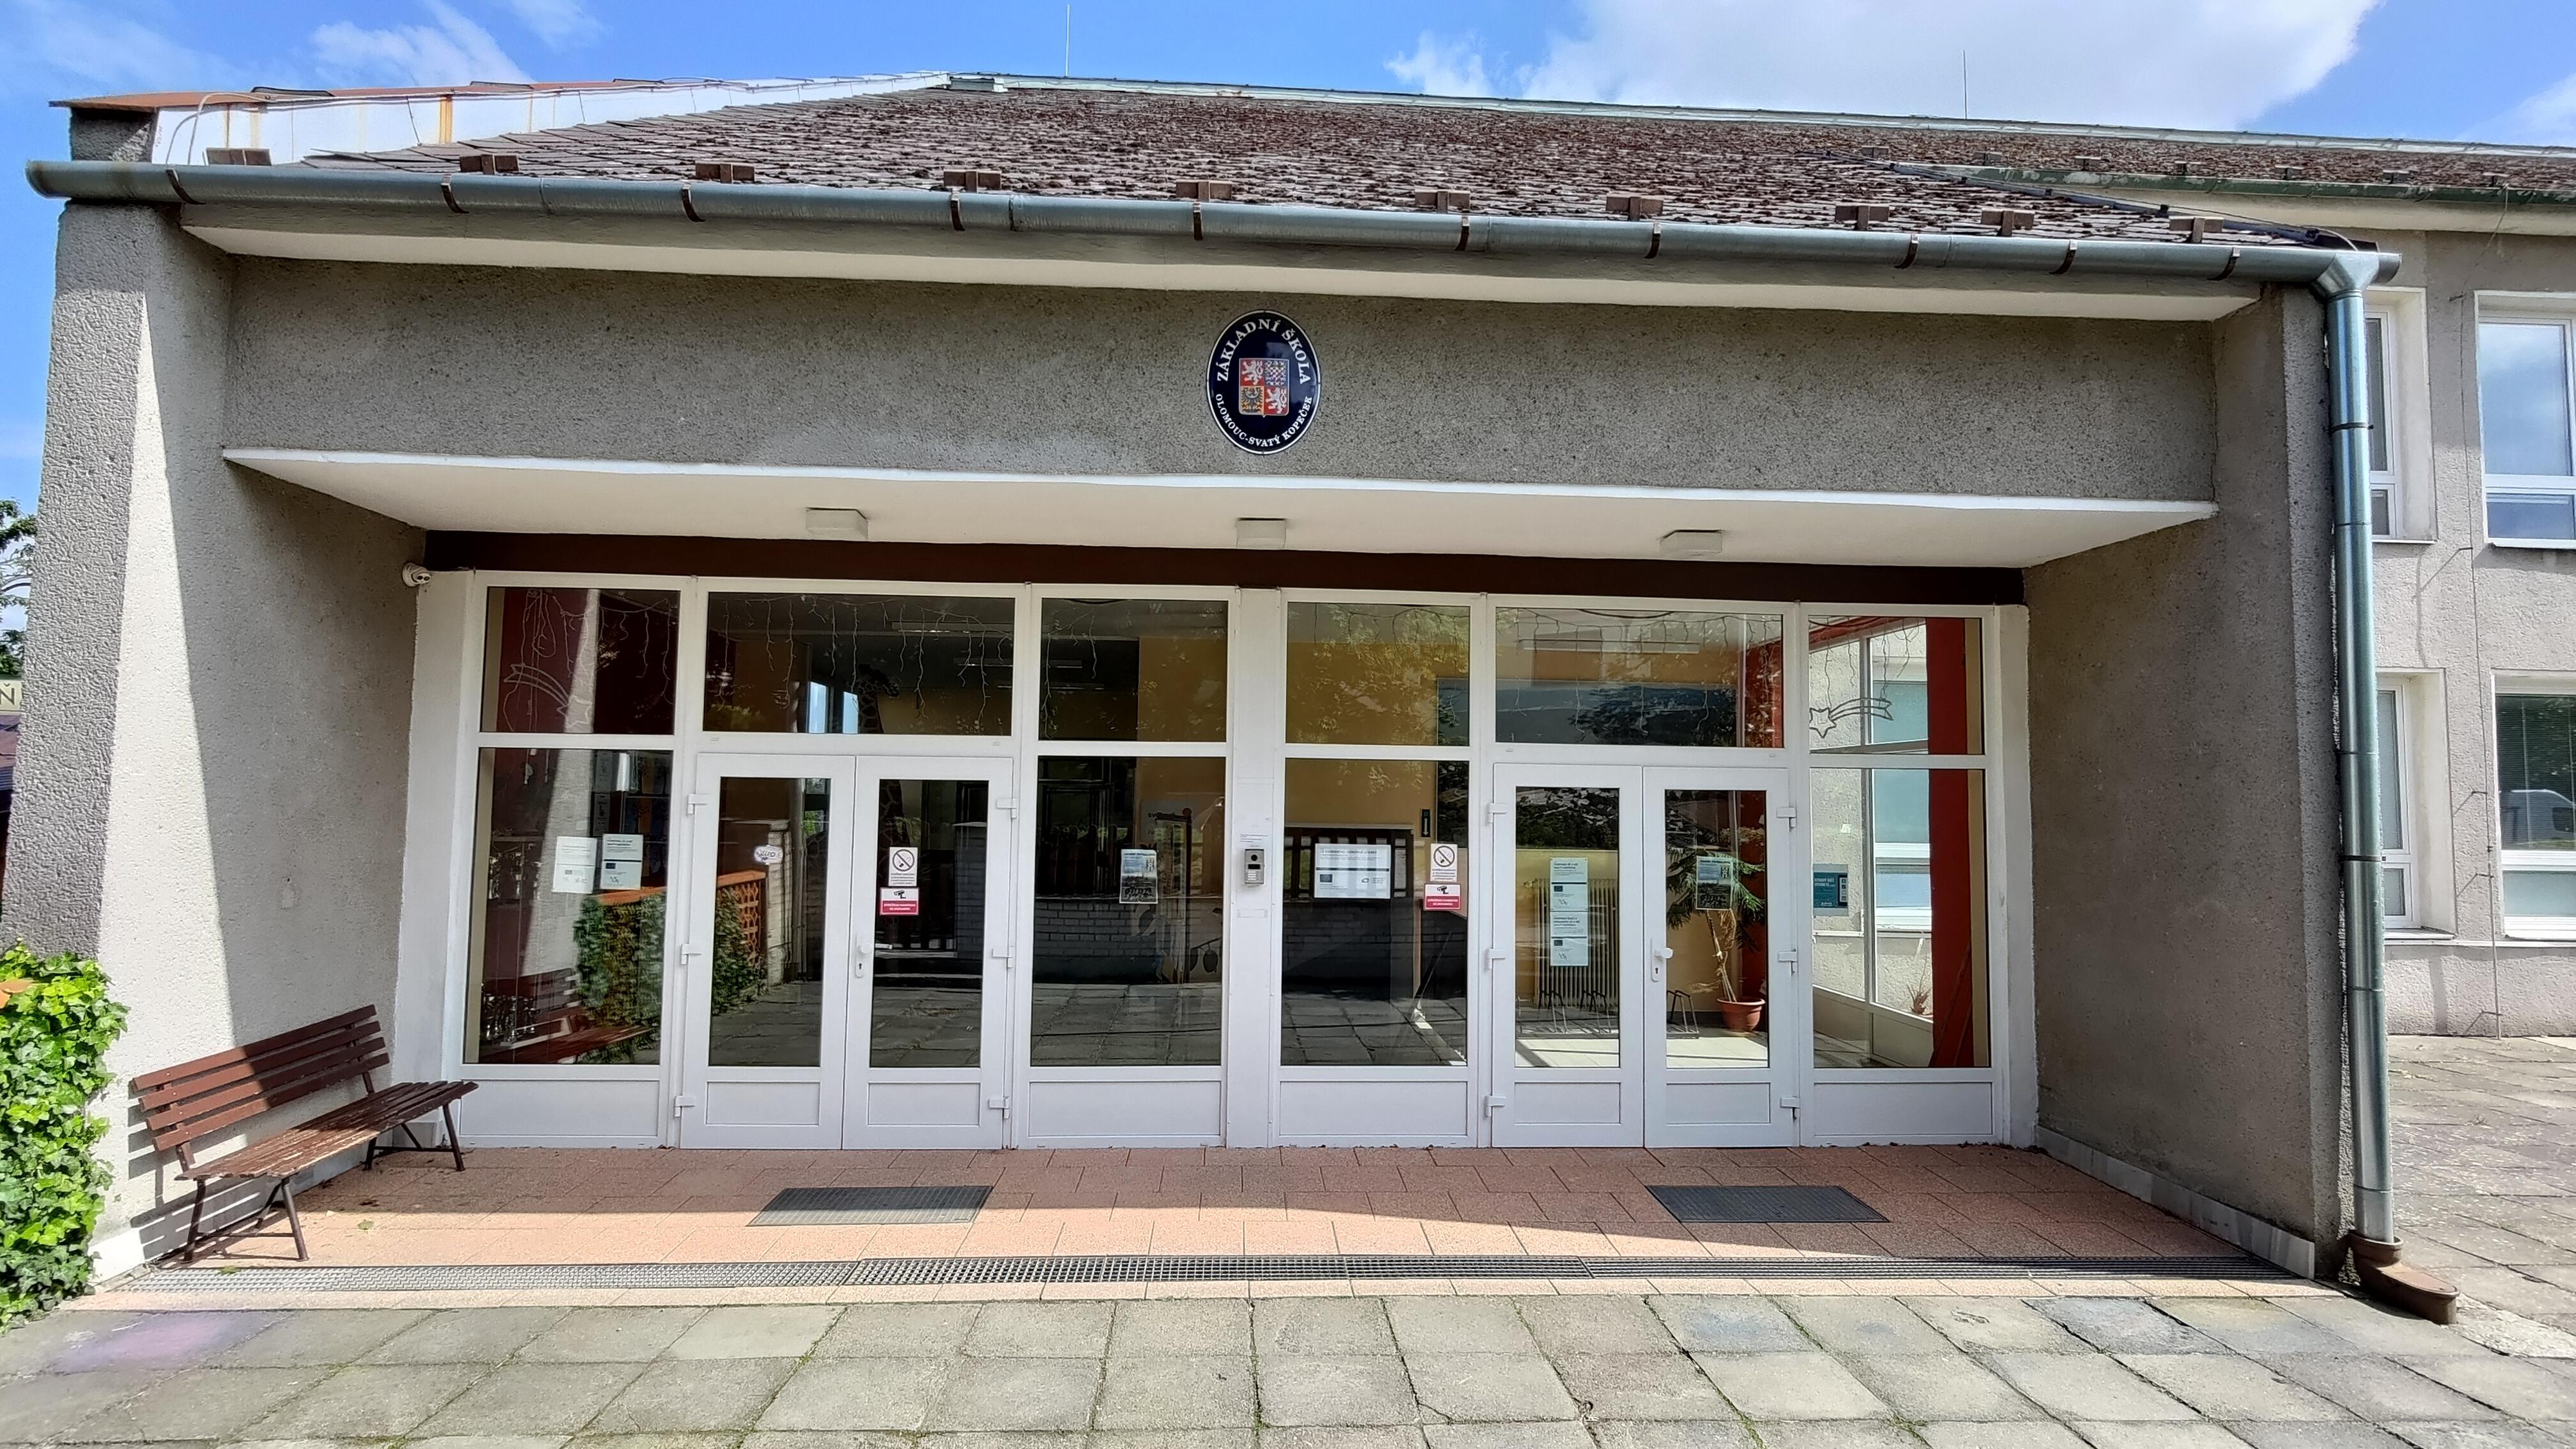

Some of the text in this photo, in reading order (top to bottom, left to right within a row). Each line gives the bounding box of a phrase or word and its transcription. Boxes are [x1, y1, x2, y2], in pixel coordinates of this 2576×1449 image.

[1216, 319, 1311, 384] ZÁKLADNÍ ŠKOLA
[1215, 393, 1312, 447] OLOMOUC-SVATÝ KOPEČEK
